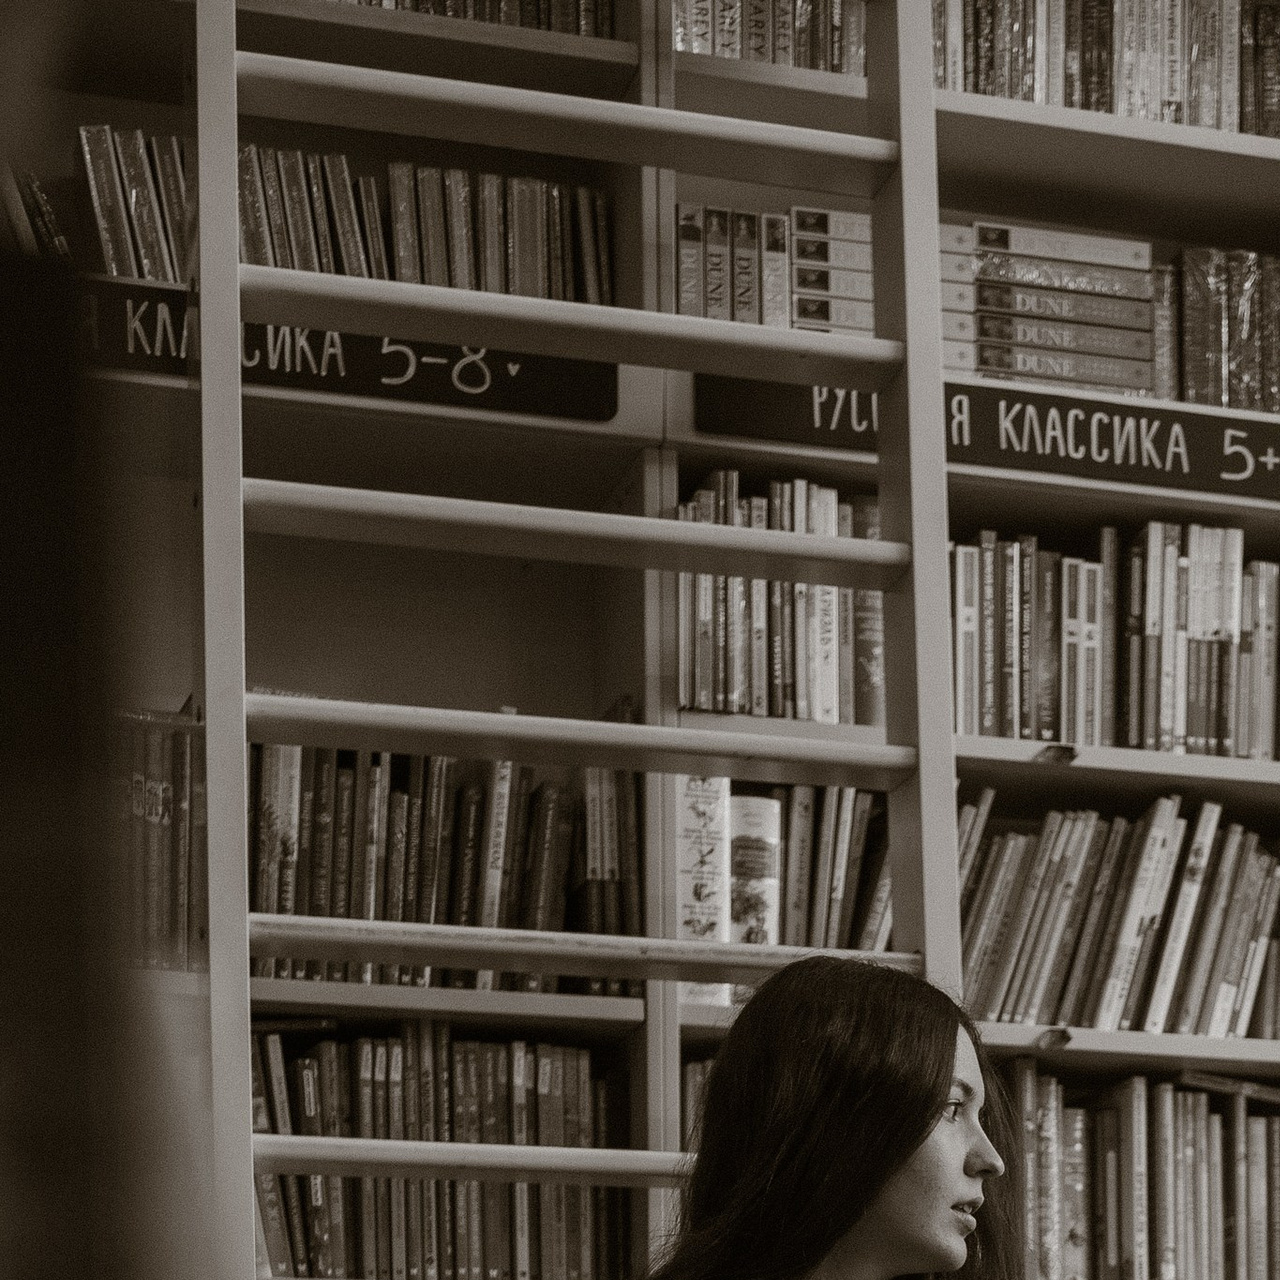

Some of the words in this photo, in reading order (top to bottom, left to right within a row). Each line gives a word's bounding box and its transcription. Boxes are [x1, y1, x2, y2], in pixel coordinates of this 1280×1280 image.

[707, 253, 723, 308] DUNE
[735, 257, 752, 312] DUNE
[1015, 293, 1076, 317] DUNE
[1015, 323, 1076, 348] DUNE
[1016, 353, 1077, 377] DUNE
[999, 400, 1191, 474] КЛАССИКА
